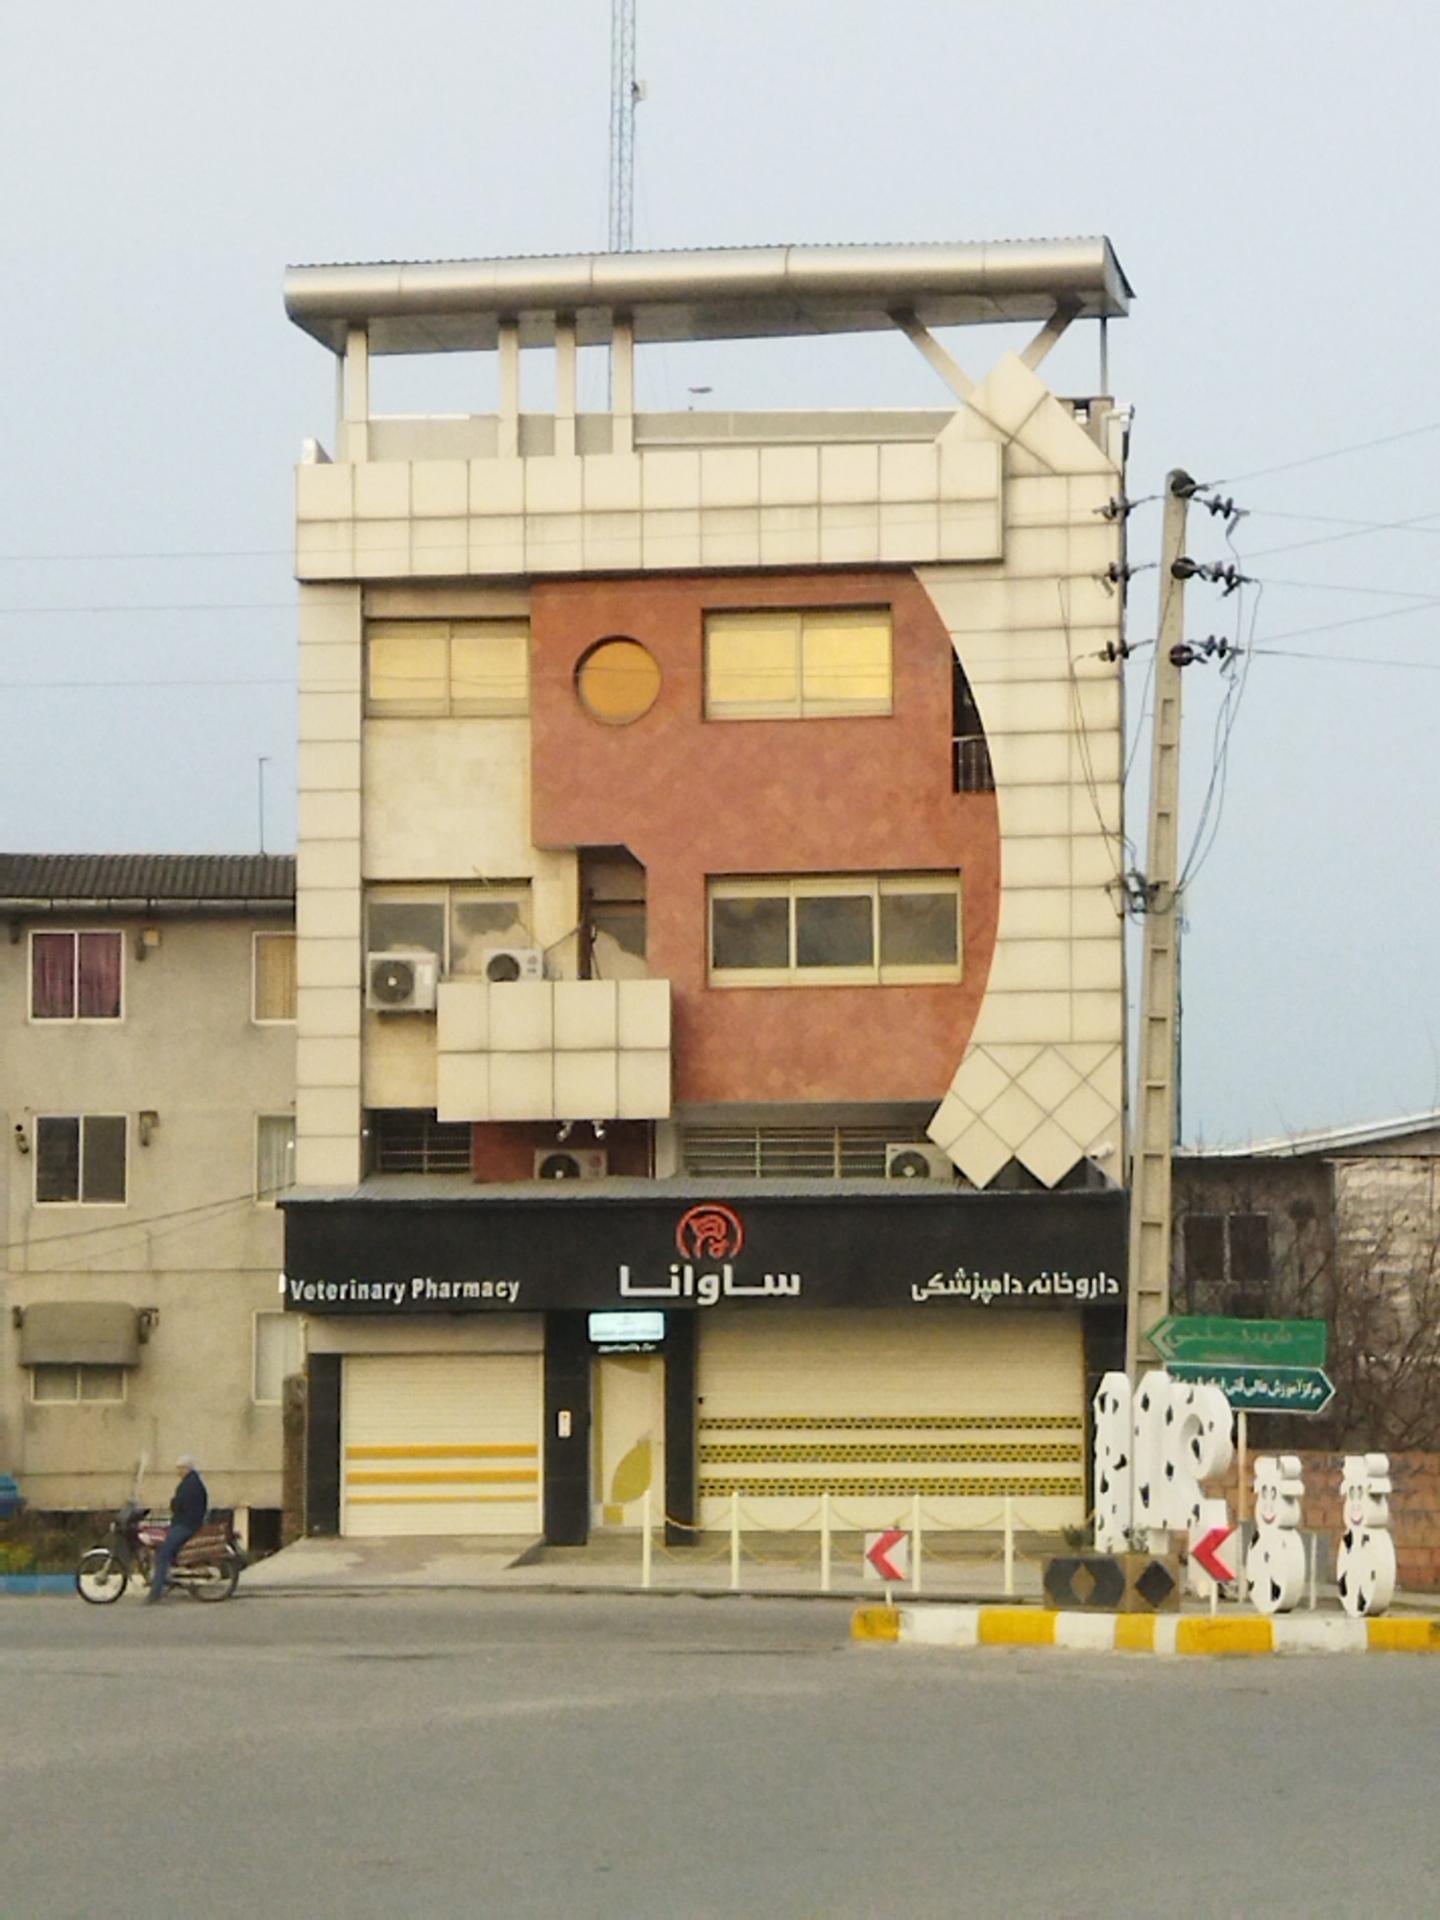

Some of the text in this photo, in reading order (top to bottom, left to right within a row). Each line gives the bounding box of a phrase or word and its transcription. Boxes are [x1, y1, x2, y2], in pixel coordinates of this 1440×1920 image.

[290, 1276, 520, 1305] Veterinary Pharmacy
[619, 1264, 801, 1306] ساوانا
[911, 1268, 1120, 1304] داروخانه دامپزشکی
